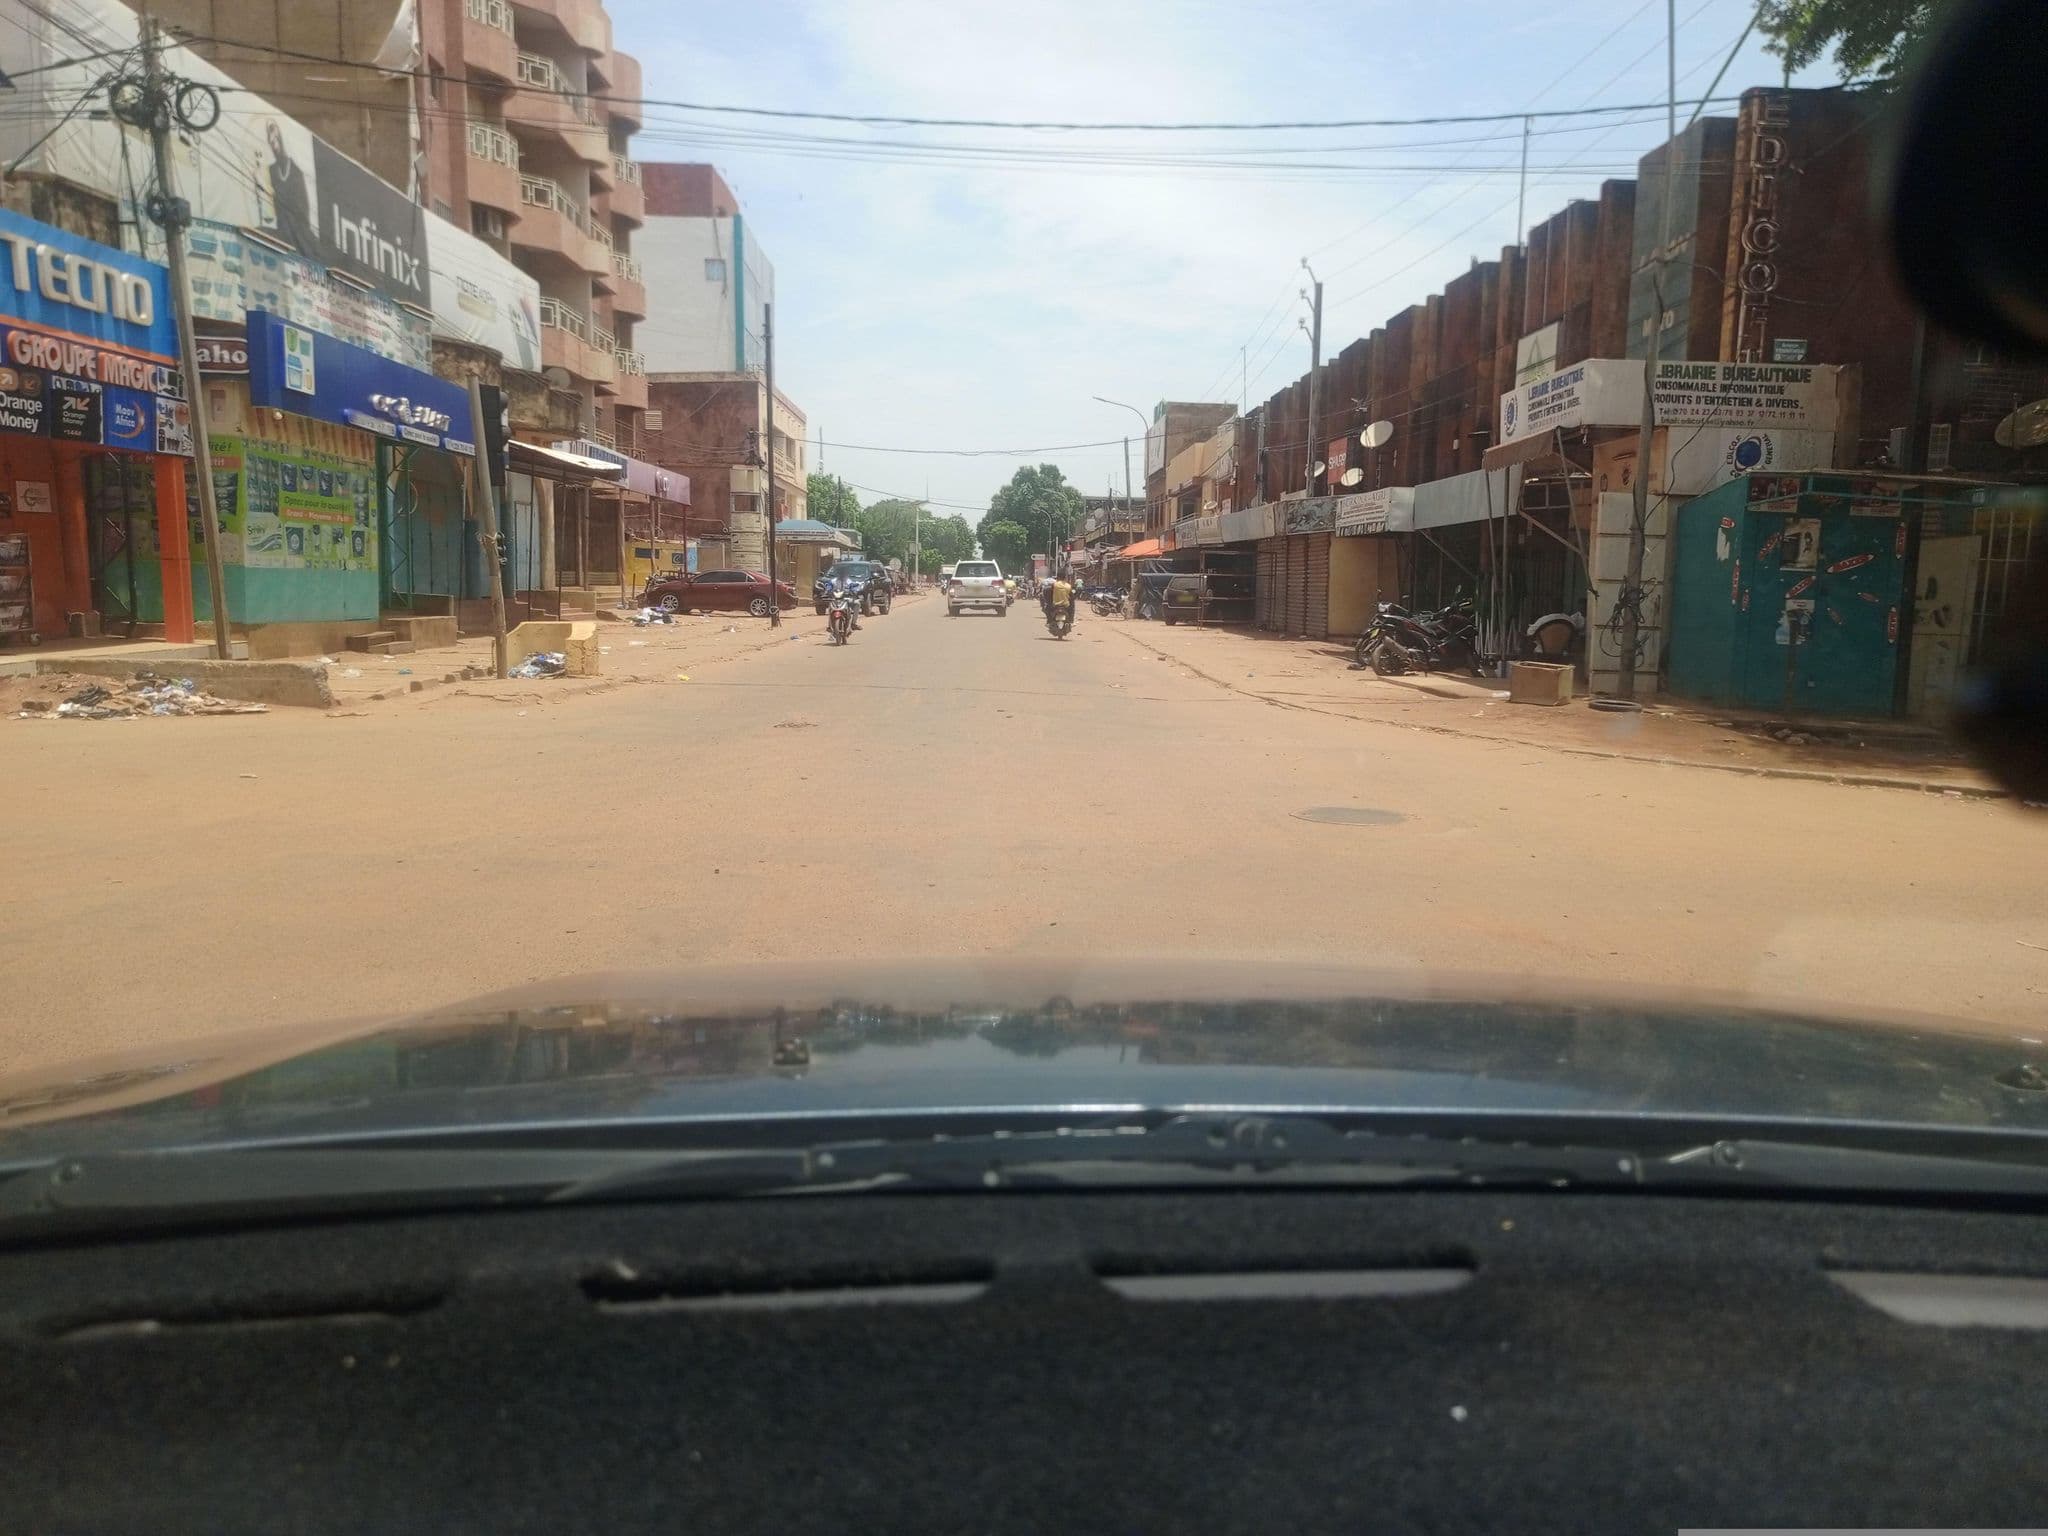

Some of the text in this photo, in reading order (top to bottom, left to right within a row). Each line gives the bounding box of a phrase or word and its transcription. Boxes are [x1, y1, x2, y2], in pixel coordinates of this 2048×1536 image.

[332, 203, 421, 292] Infinix
[0, 230, 154, 327] TECNO
[7, 329, 158, 393] GROUPE MAGIC
[1722, 366, 1812, 384] BUREAUTIQUE
[1655, 380, 1785, 396] ONSOMMABLE INFORMATIQUE
[0, 391, 44, 417] Orange
[1653, 394, 1693, 405] RODUITS
[1695, 395, 1753, 408] D'ENTRETIEN
[1754, 398, 1764, 408] &
[114, 402, 136, 418] Moov
[0, 410, 39, 434] Money
[62, 416, 85, 428] Money
[114, 414, 137, 429] Africa
[283, 495, 304, 507] Optez
[304, 499, 319, 508] pour
